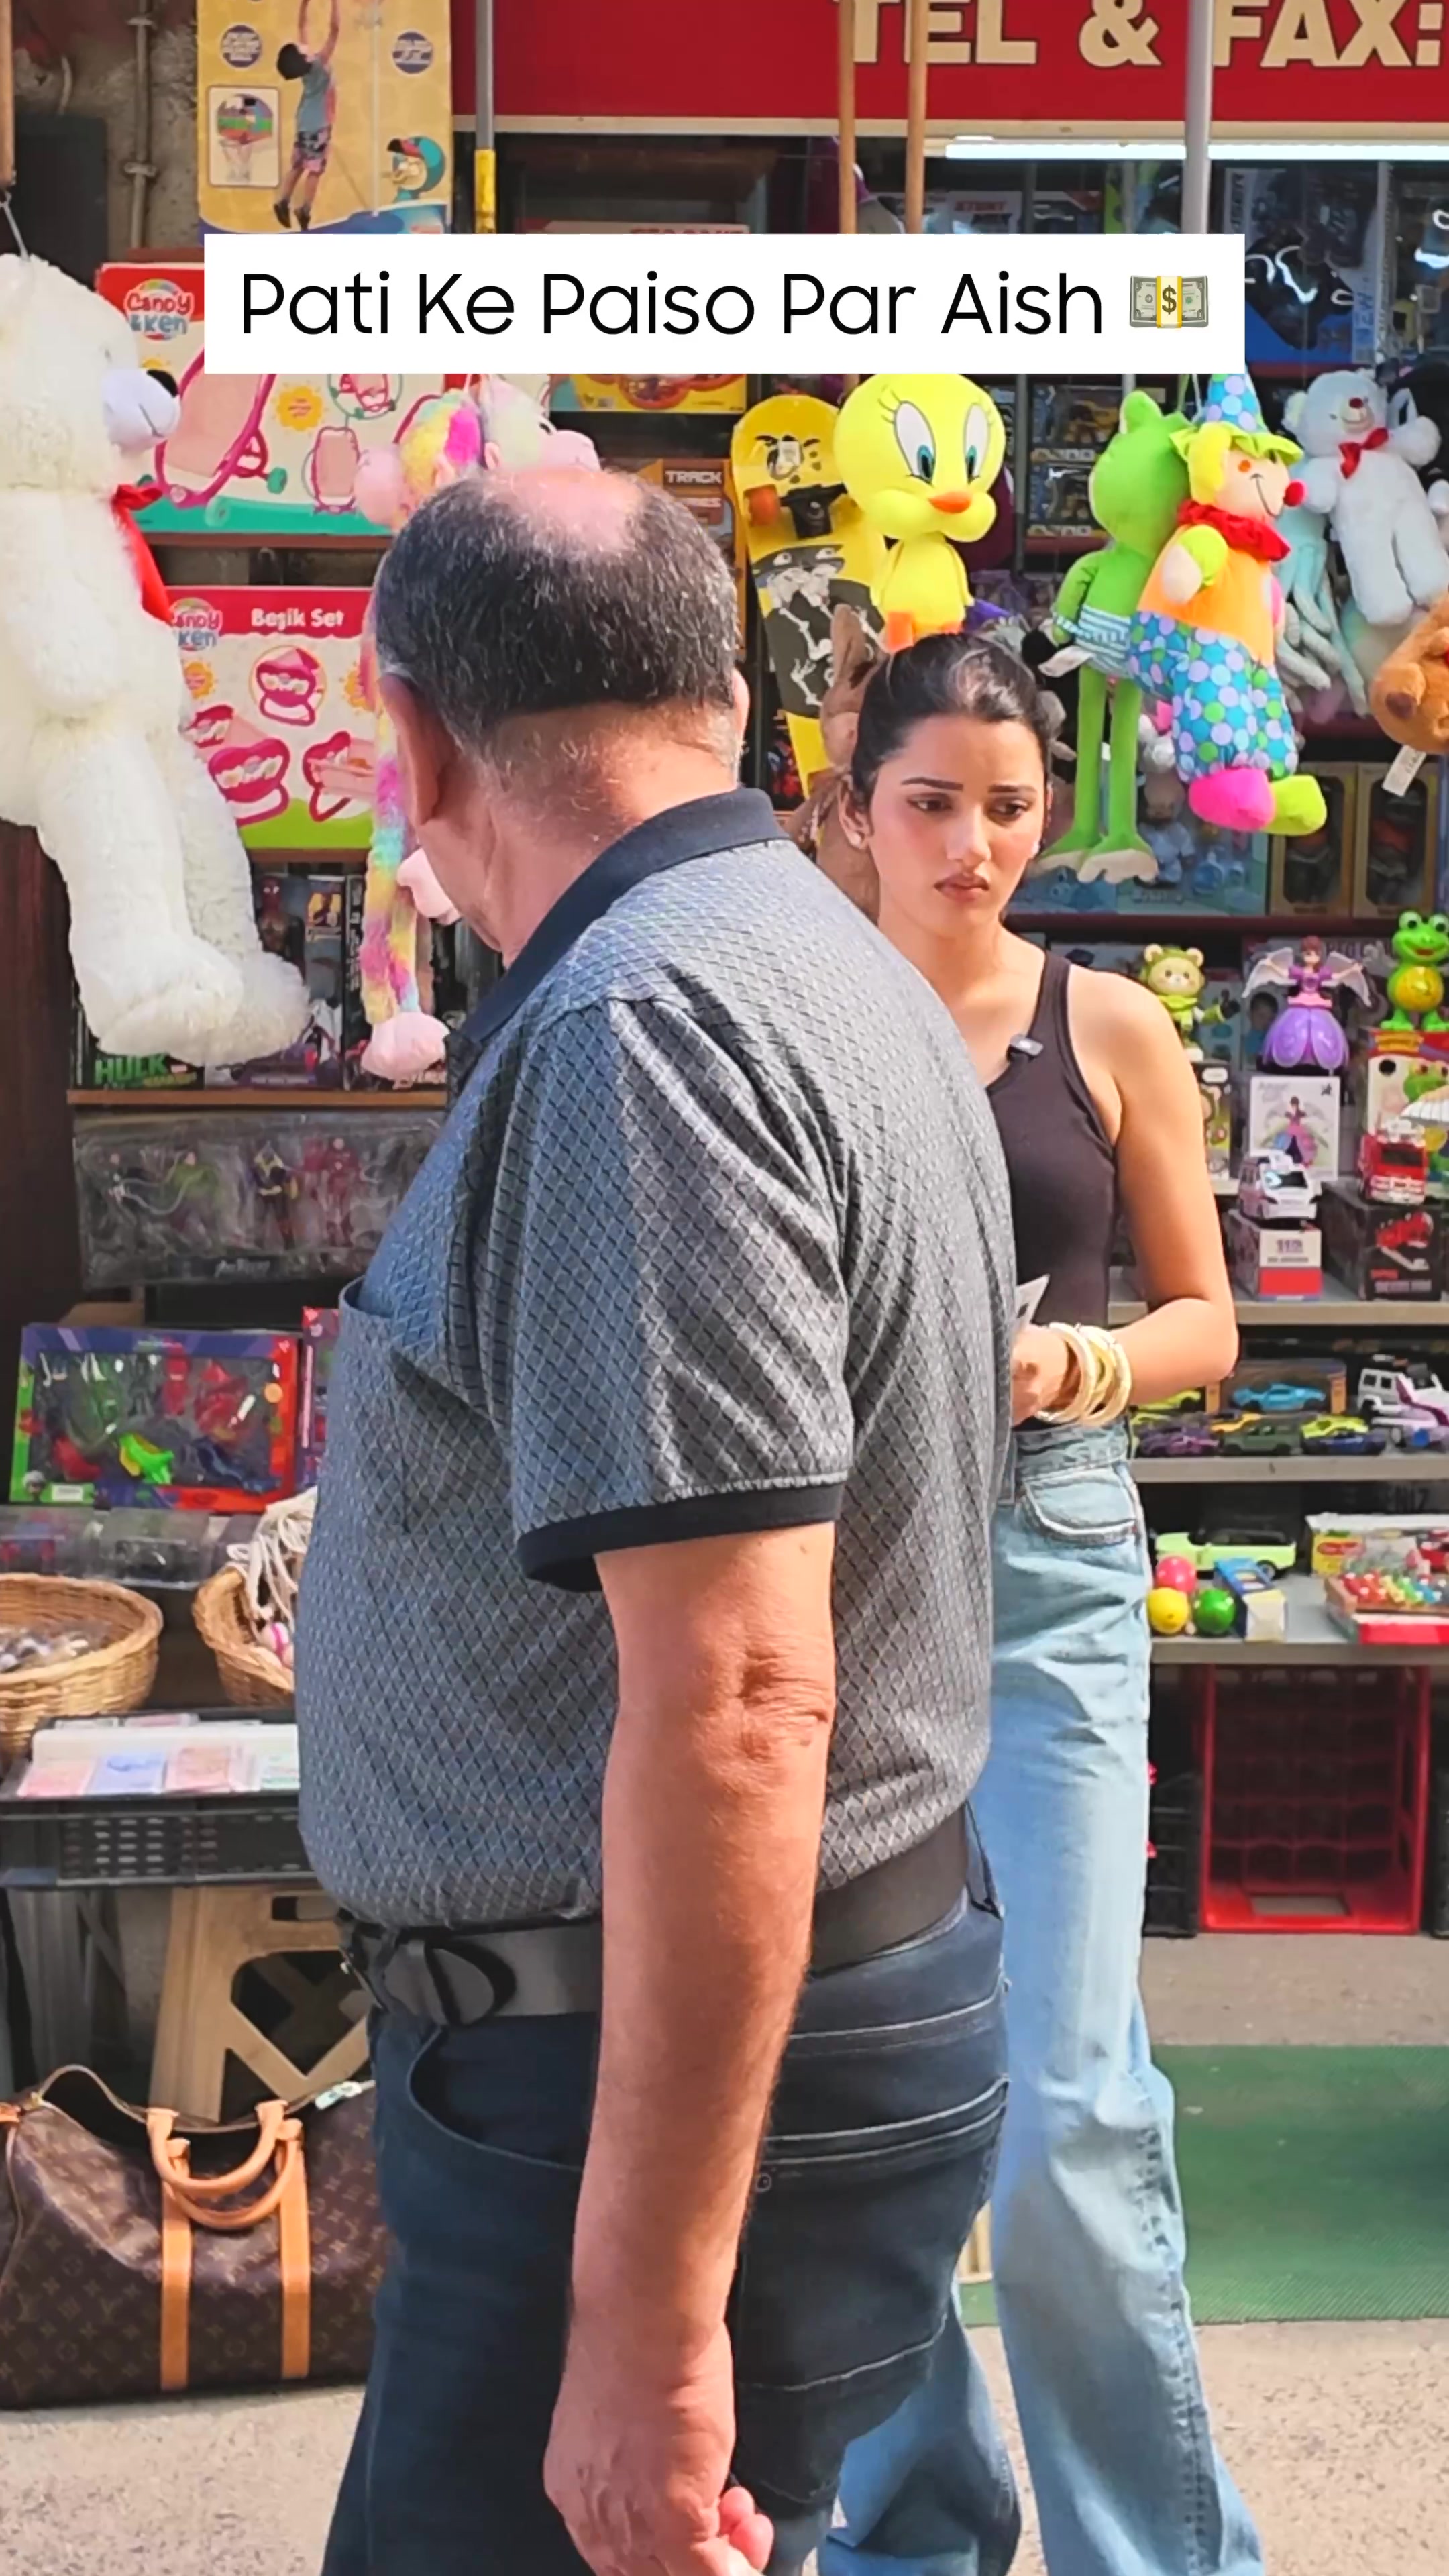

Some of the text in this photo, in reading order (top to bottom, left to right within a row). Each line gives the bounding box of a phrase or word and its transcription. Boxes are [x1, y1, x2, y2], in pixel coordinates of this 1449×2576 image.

[833, 0, 1443, 67] TEL & FAX:
[664, 470, 723, 484] TRACK
[175, 609, 221, 630] andy
[311, 608, 345, 627] Set
[95, 1053, 167, 1085] HULK
